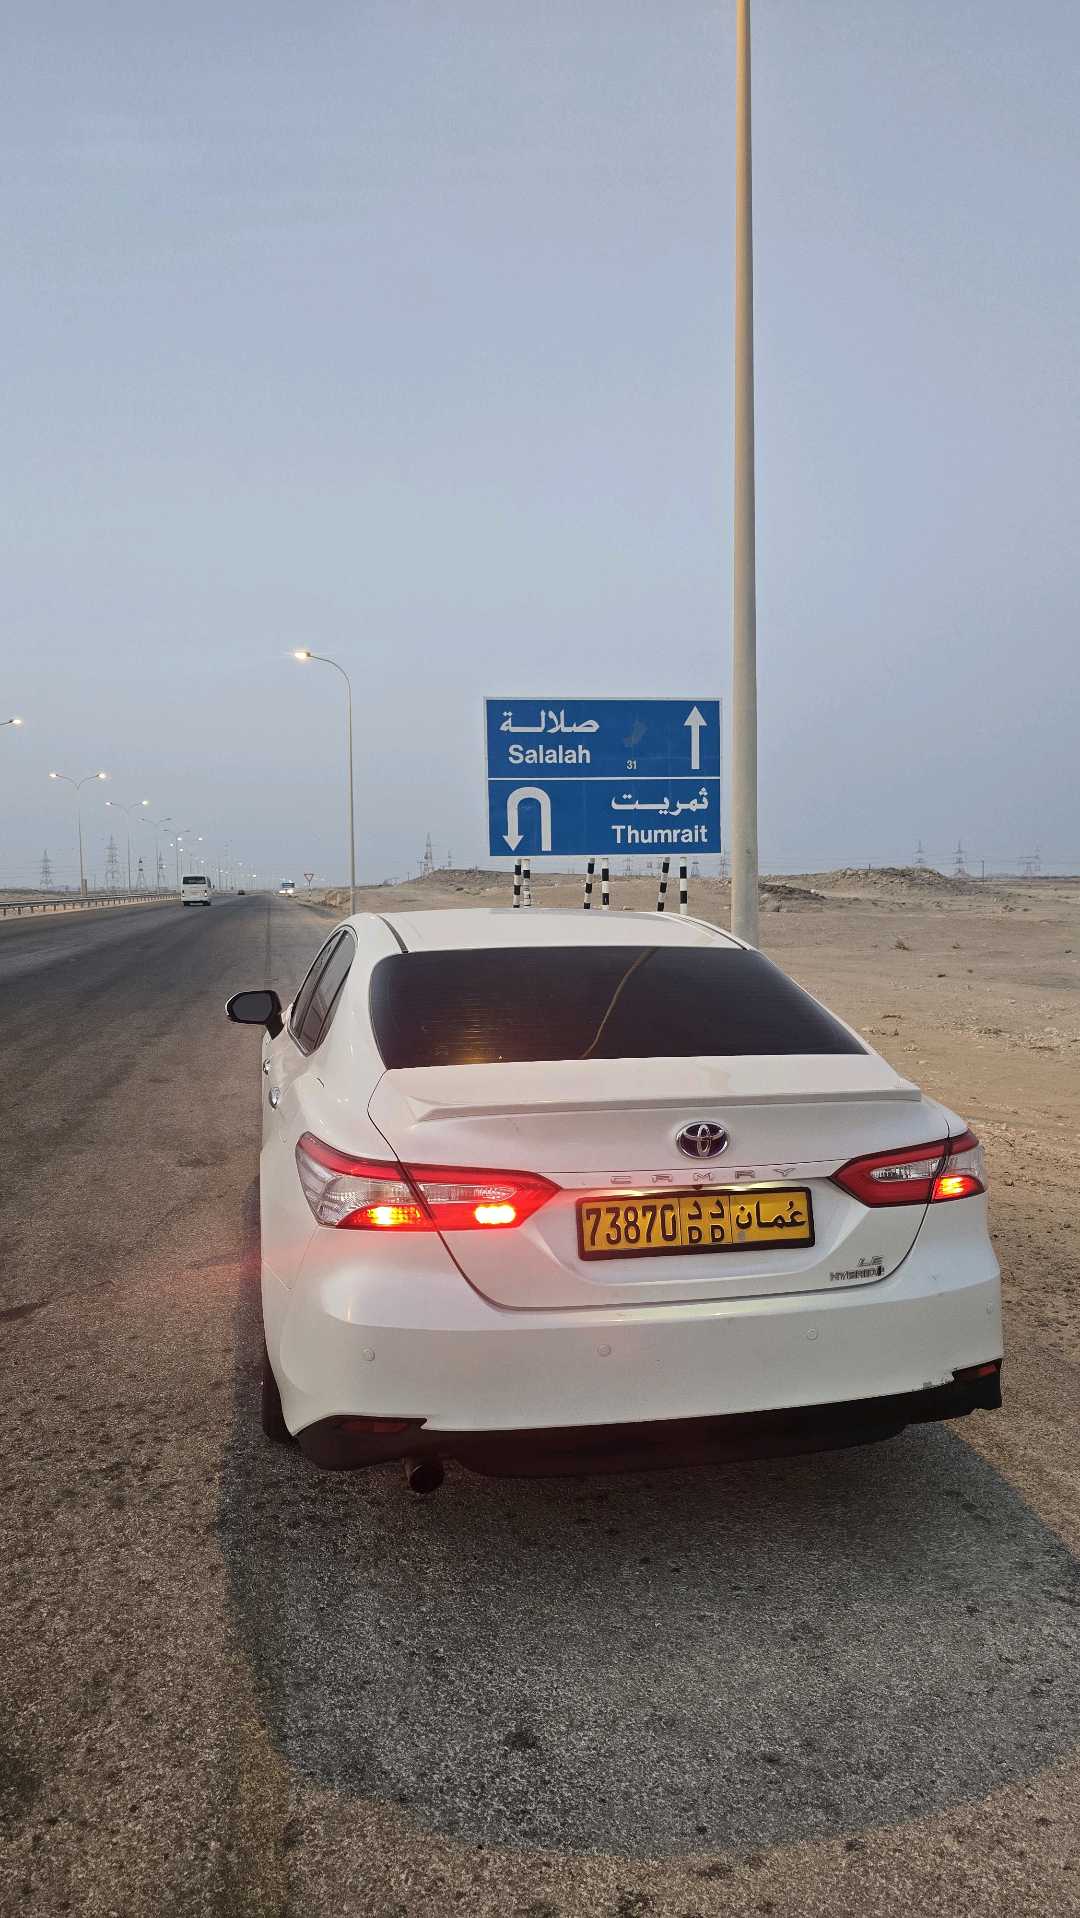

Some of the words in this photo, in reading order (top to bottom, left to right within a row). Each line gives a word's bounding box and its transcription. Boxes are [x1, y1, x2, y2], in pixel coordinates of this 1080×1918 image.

[499, 709, 600, 735] صلالة
[508, 744, 591, 765] Salalah
[626, 760, 638, 770] 31
[610, 786, 709, 816] ثمريت
[611, 825, 709, 844] Thumrait
[610, 1168, 796, 1184] CAMRY
[585, 1203, 678, 1246] 73870
